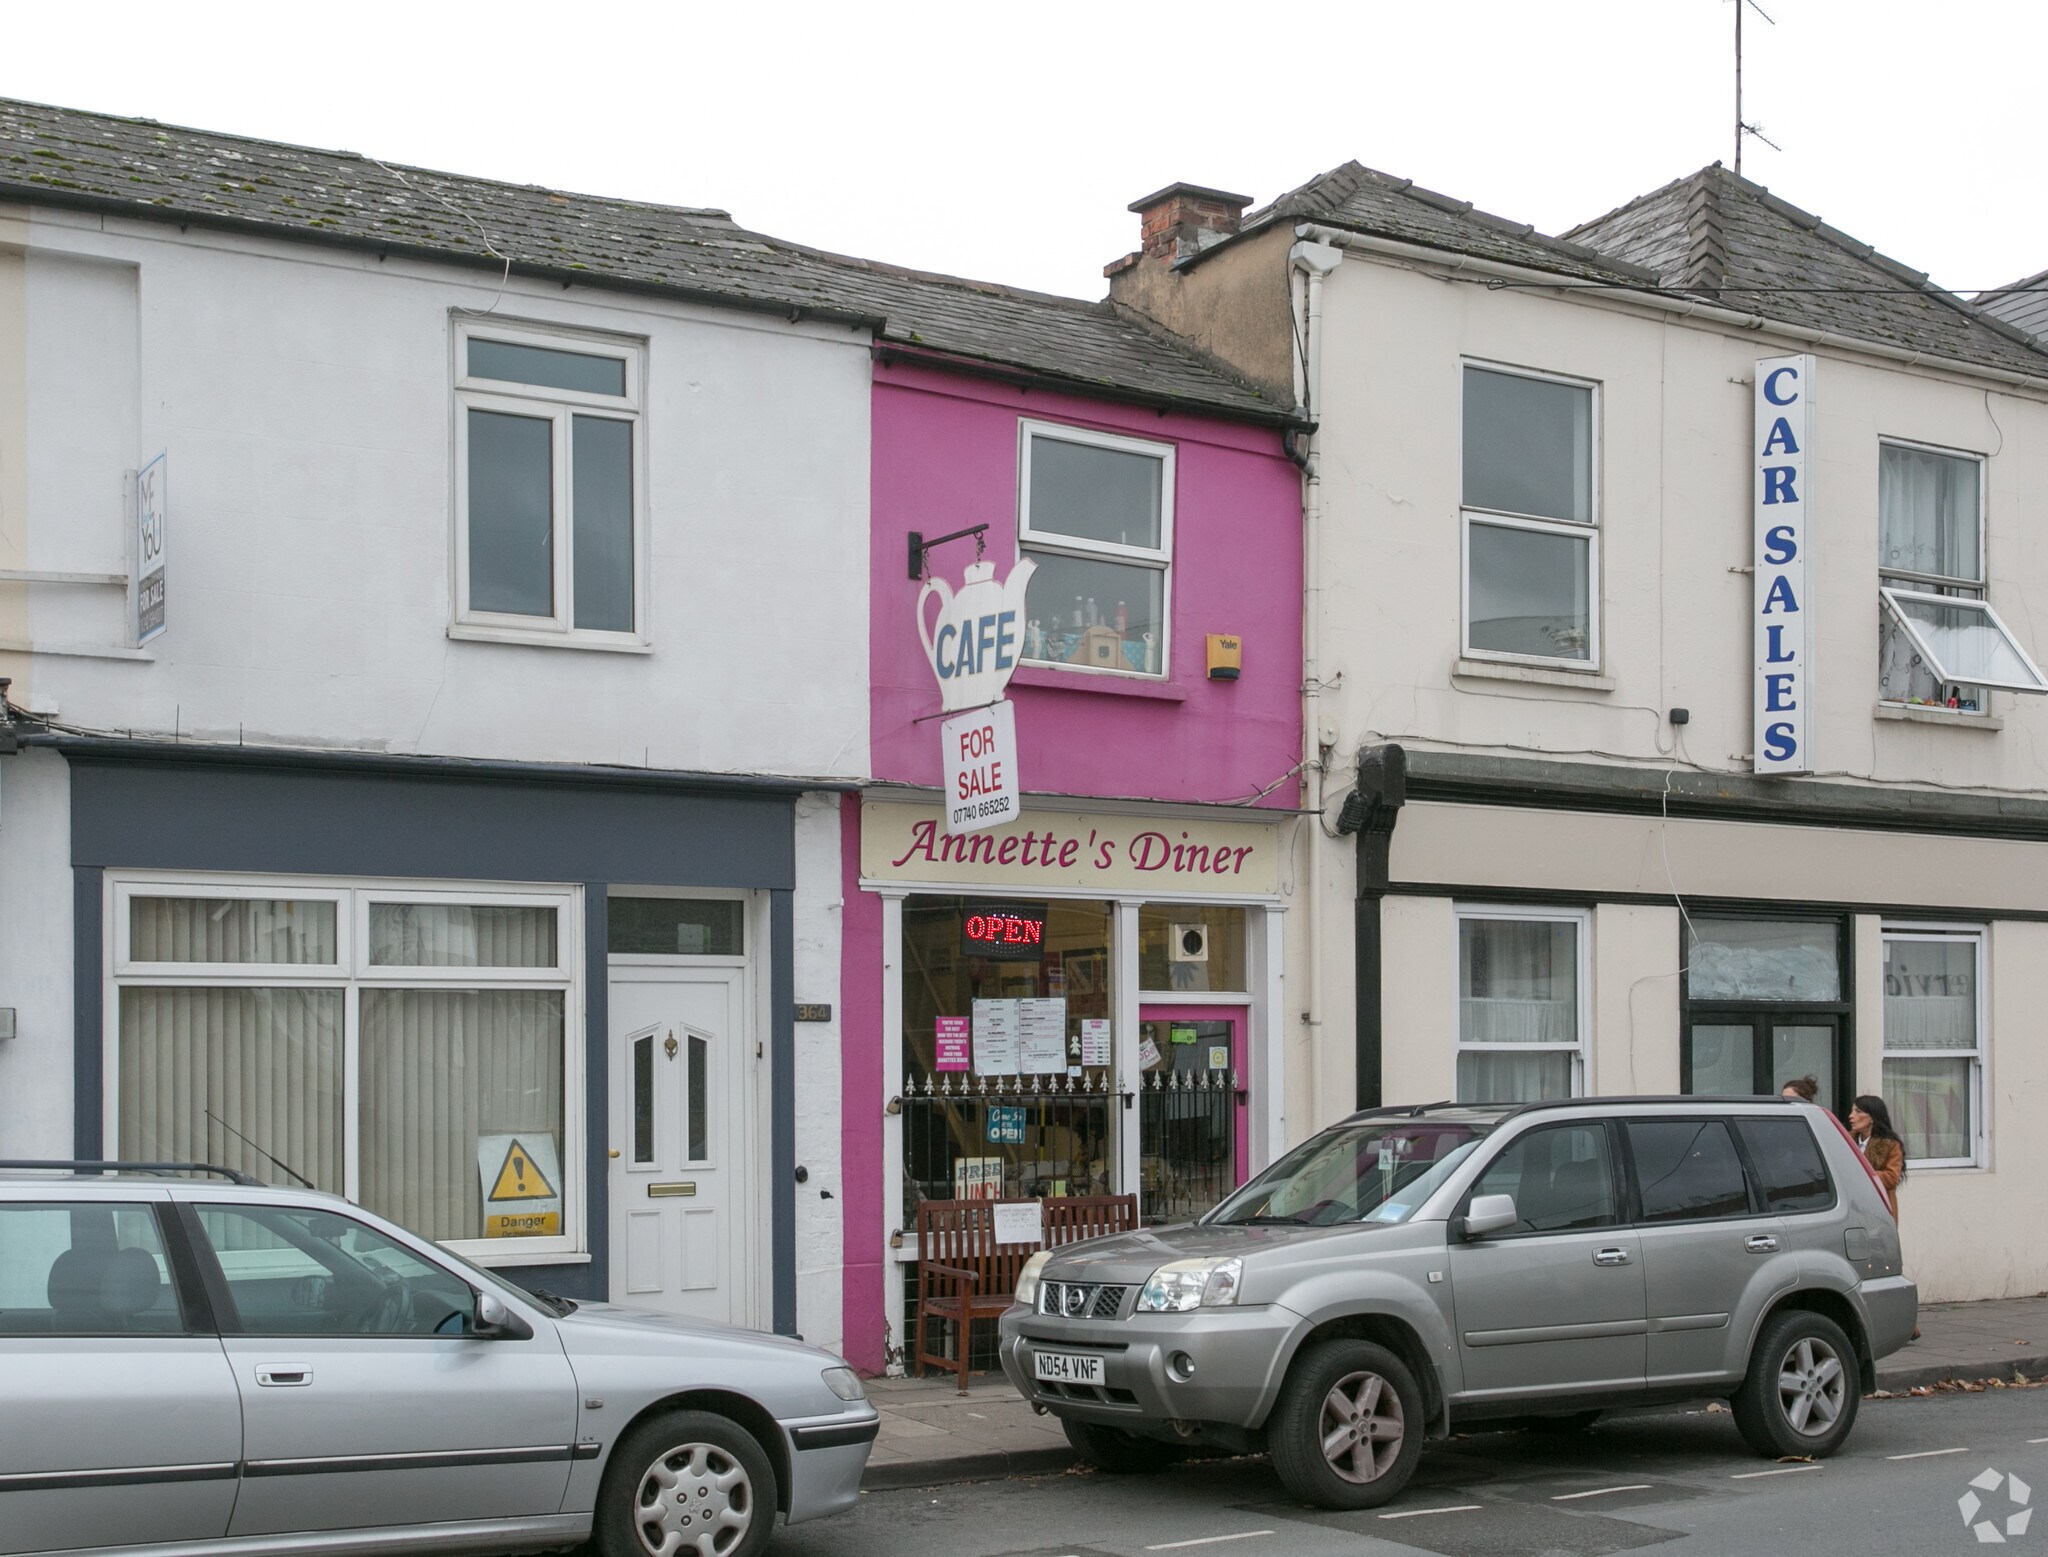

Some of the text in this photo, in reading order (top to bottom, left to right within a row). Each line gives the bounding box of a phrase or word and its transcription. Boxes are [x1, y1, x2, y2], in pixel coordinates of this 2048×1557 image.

[1762, 367, 1799, 761] CAR SALES
[150, 580, 164, 608] SALE
[936, 610, 1016, 679] CAFE
[1220, 640, 1237, 649] Yale
[960, 725, 995, 762] FOR
[958, 761, 1003, 800] SALE
[953, 796, 1010, 824] 07740 665252
[892, 820, 1254, 874] Annette's Diner
[966, 915, 1043, 944] OPEN
[799, 1005, 827, 1019] 364
[991, 1128, 1022, 1139] OPEN
[958, 1163, 1001, 1180] FREE
[501, 1217, 546, 1229] Danger
[1039, 1355, 1098, 1379] ND54 VNF
